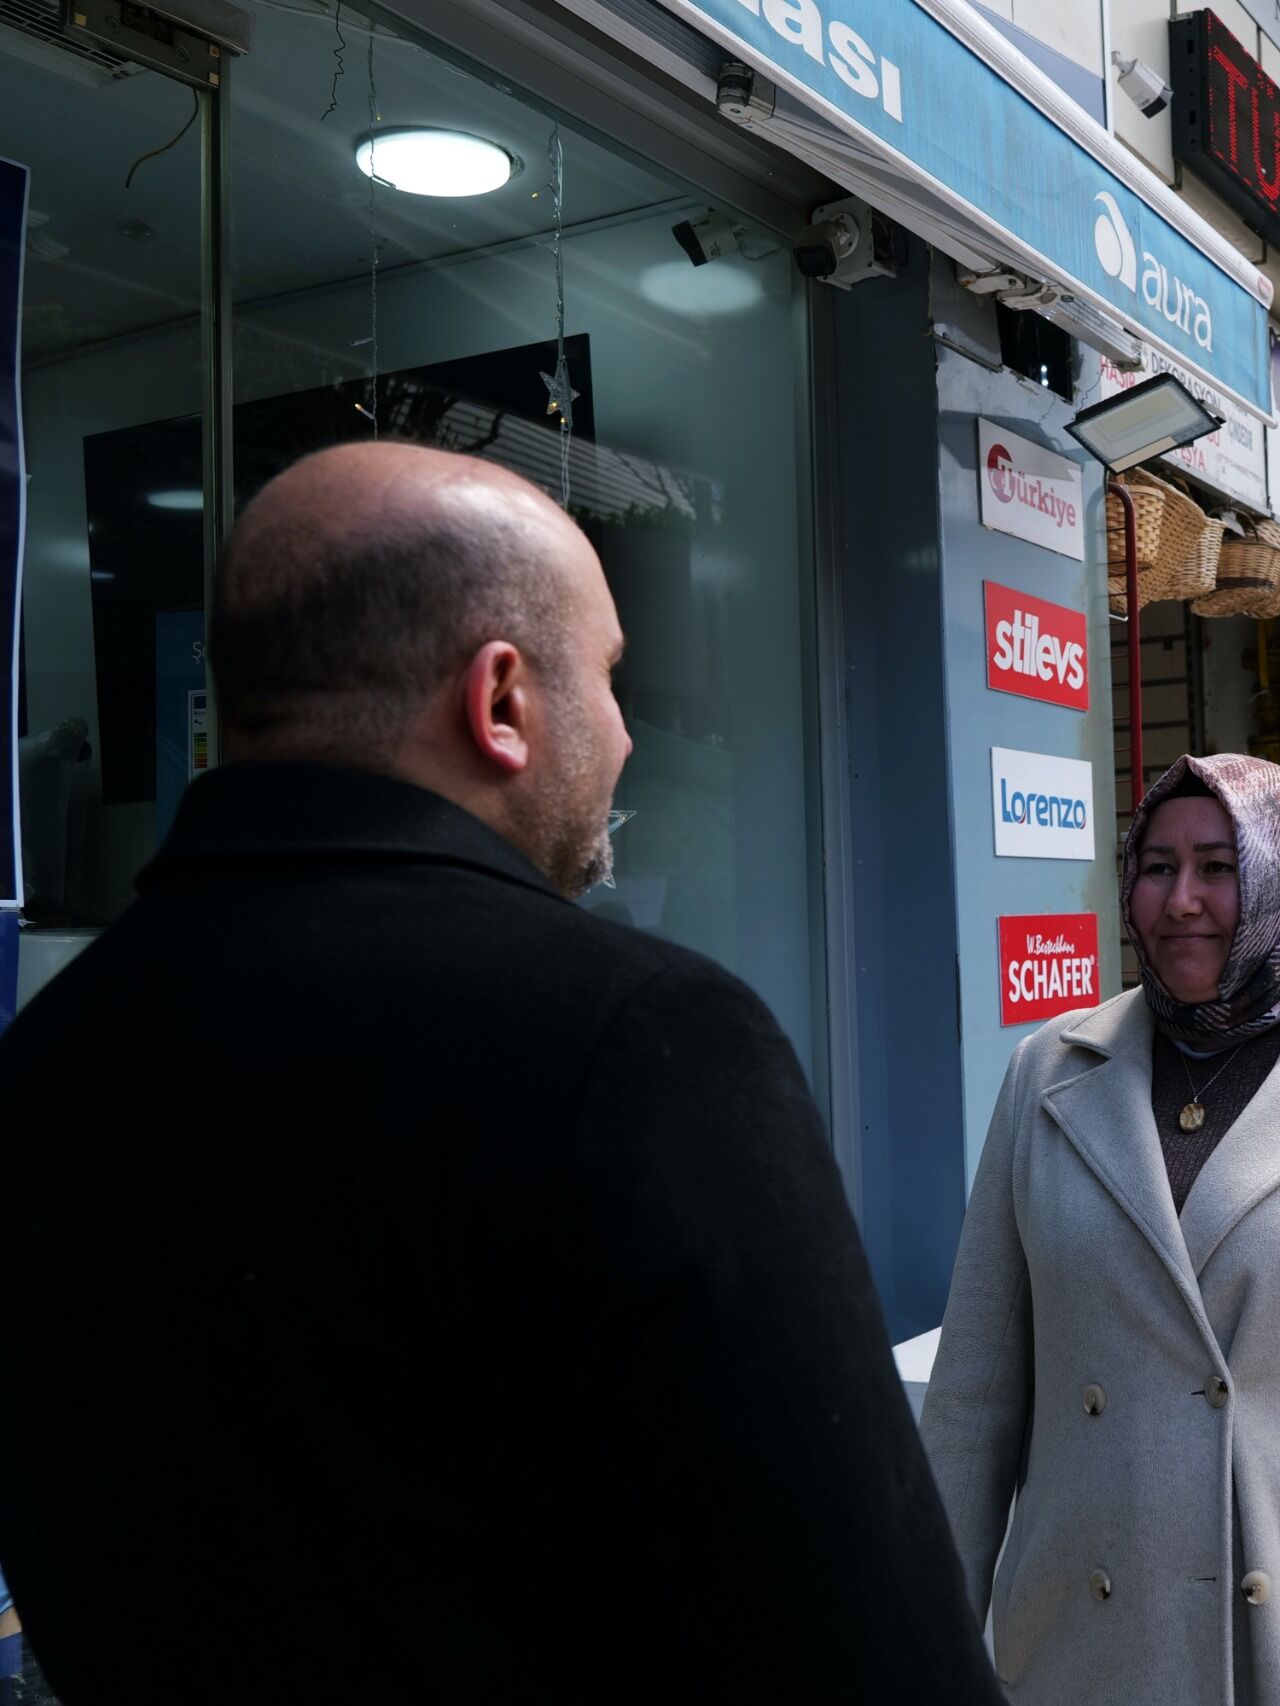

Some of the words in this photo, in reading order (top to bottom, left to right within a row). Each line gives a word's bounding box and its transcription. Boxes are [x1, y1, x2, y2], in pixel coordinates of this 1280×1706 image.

[737, 0, 903, 123] ası
[1142, 251, 1213, 353] aura
[996, 455, 1077, 529] Türkiye
[993, 609, 1085, 691] stilevs
[1000, 778, 1087, 830] Lorenzo
